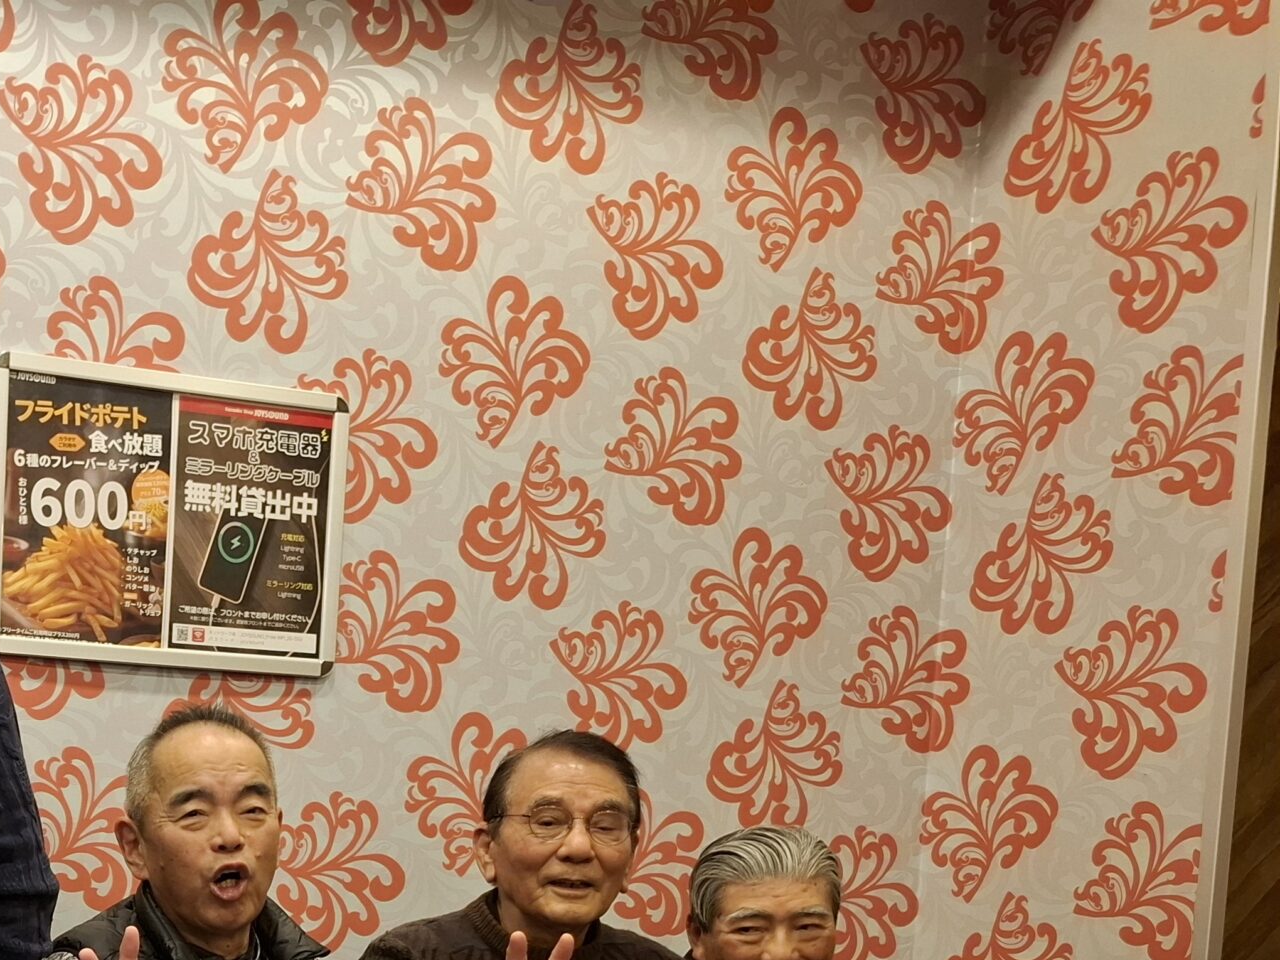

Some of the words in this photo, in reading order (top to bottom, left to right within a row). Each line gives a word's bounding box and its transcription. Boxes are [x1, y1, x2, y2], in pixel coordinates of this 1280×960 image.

[17, 371, 57, 385] JOYSOUND
[15, 399, 147, 430] フライドポテト
[253, 409, 289, 421] JOYSOUND
[88, 430, 163, 457] 食べ放題
[188, 420, 321, 458] スマホ充電器
[13, 448, 160, 474] 6種のフレーバー&ディップ
[248, 451, 260, 464] &
[185, 457, 320, 488] ミラーリングケーブル
[184, 479, 318, 523] 無料貸出中
[282, 554, 302, 562] Type-C
